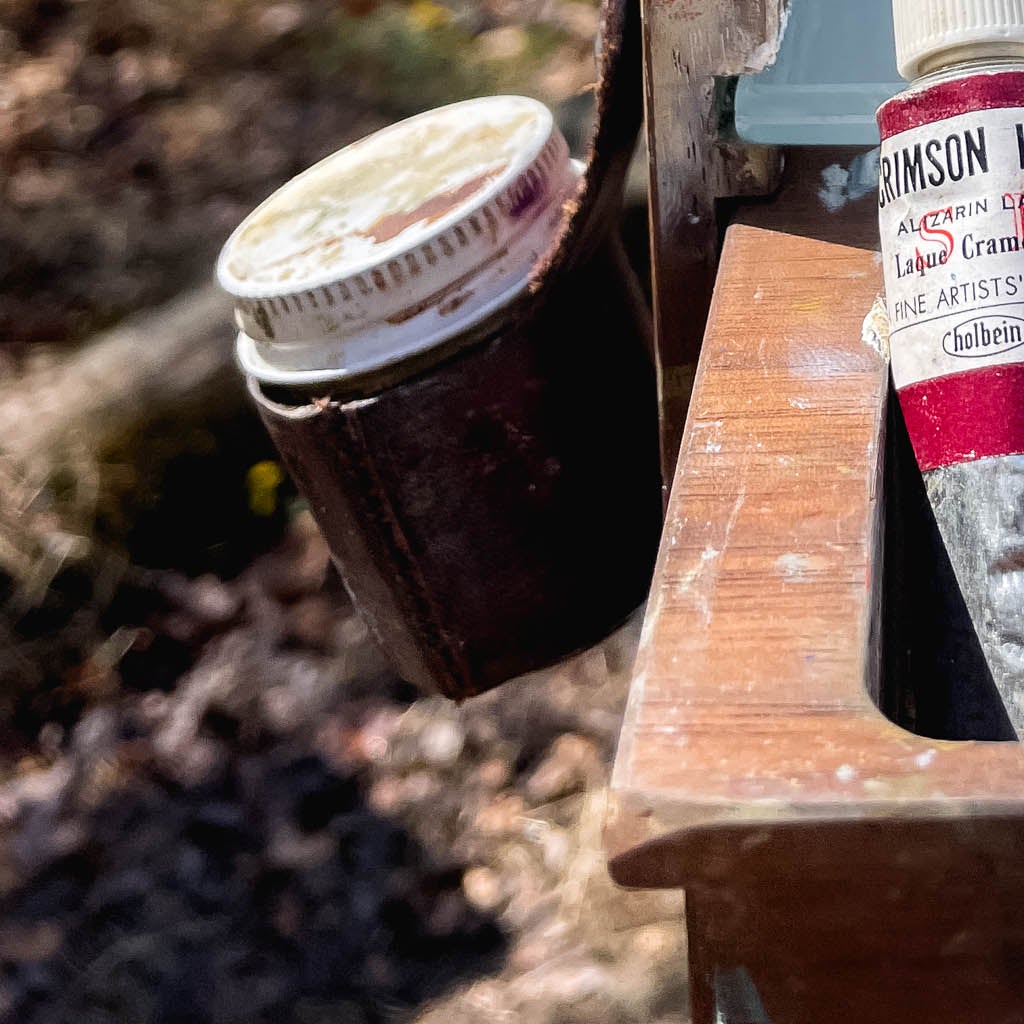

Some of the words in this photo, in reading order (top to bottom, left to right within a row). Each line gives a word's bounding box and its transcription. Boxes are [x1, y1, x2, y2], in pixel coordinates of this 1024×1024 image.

[897, 198, 989, 236] ALIZARIN
[895, 248, 947, 279] Laque
[895, 294, 927, 322] FINE
[936, 276, 1024, 309] ARTISTS'
[953, 320, 1022, 353] holbein
